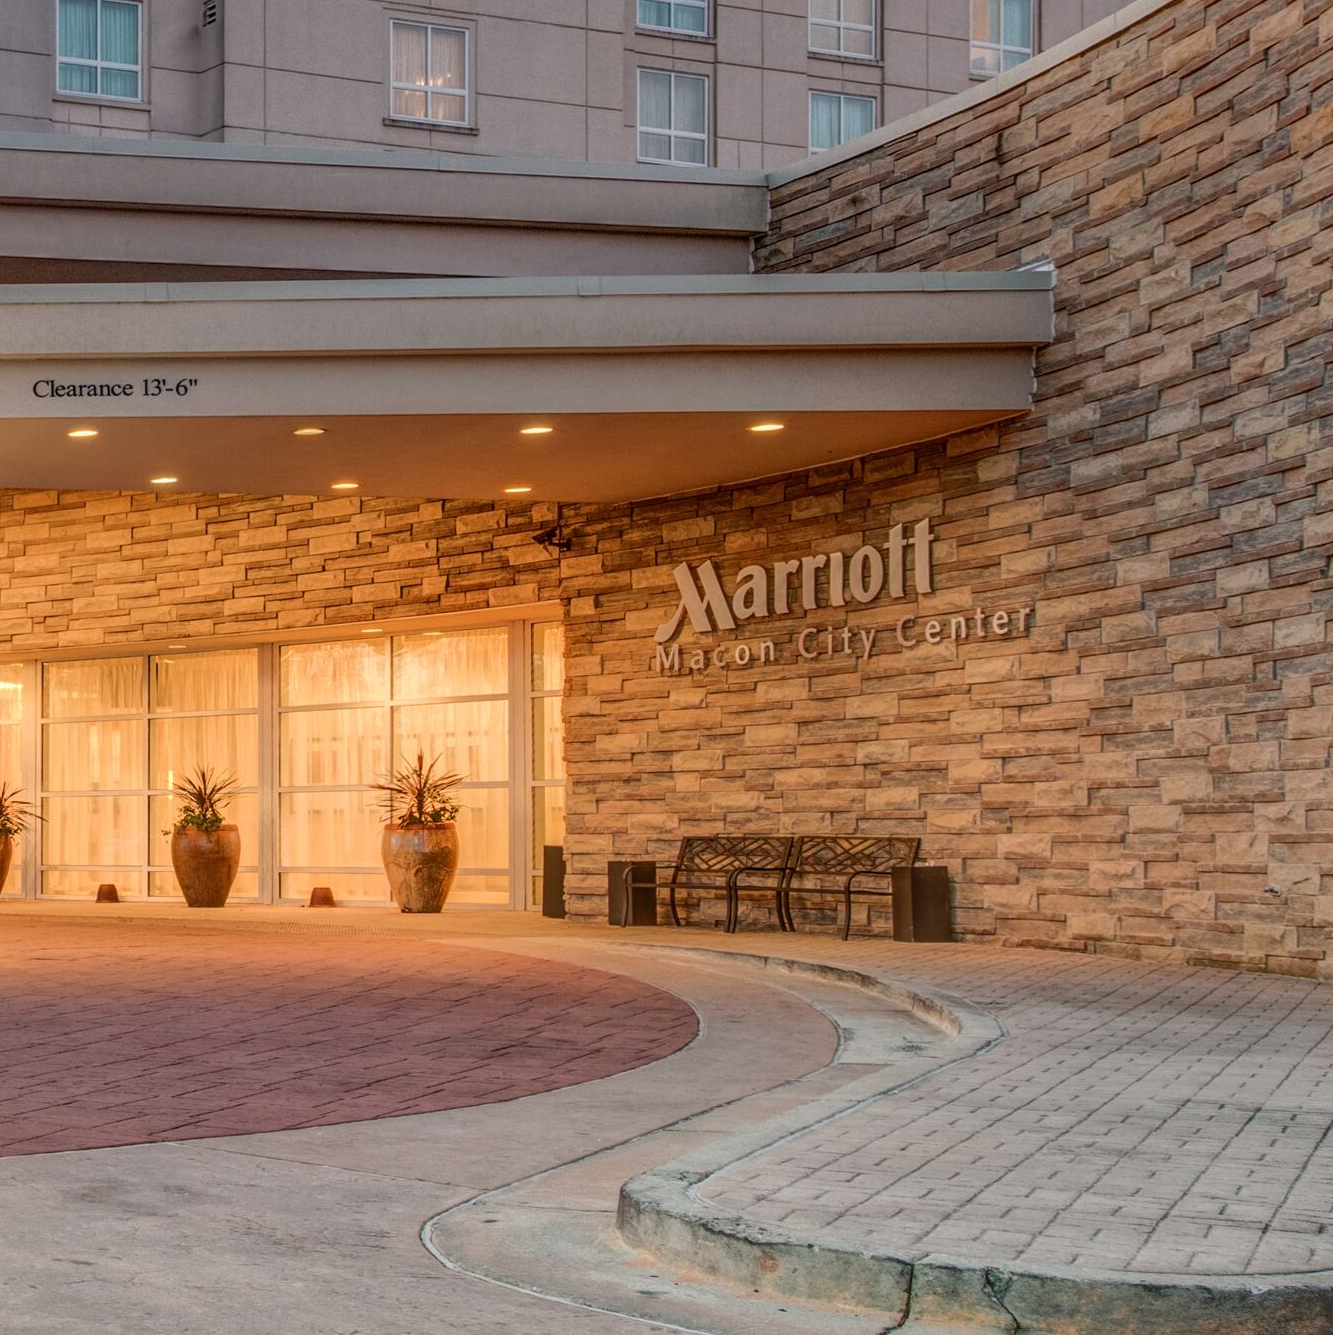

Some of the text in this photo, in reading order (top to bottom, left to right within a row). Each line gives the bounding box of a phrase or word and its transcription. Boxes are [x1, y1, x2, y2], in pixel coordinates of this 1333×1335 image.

[32, 378, 198, 398] Clearance 13'-6"
[653, 517, 935, 643] Marriott
[654, 606, 1031, 672] Macon City Center
